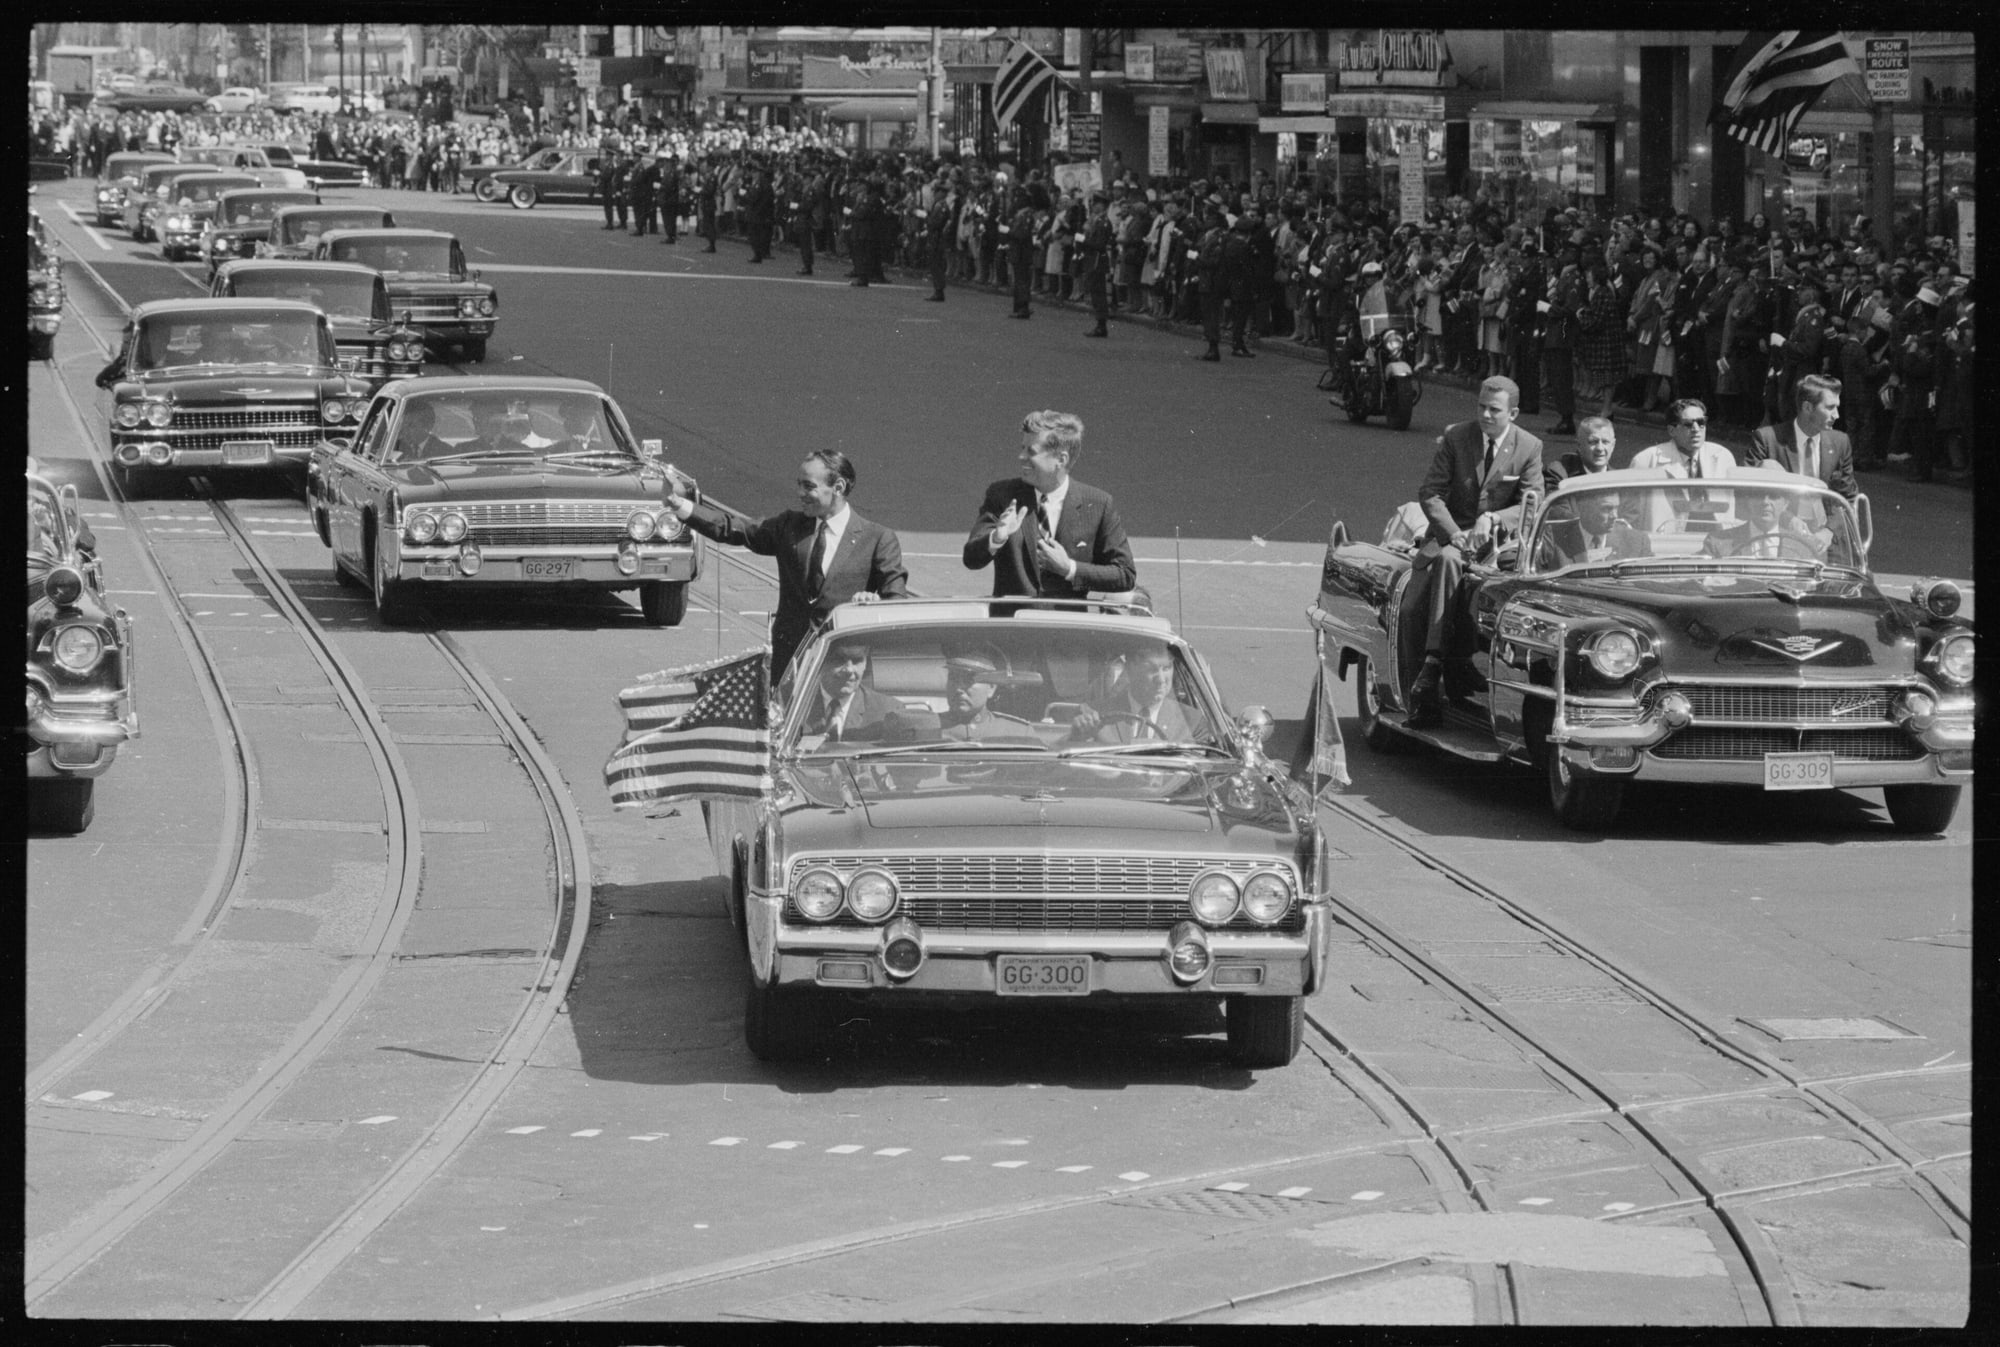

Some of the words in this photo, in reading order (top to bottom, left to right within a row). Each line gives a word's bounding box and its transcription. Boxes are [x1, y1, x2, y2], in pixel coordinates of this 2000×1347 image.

[1873, 41, 1902, 51] SNOW
[1871, 58, 1904, 68] ROUTE
[1874, 80, 1902, 89] DURING
